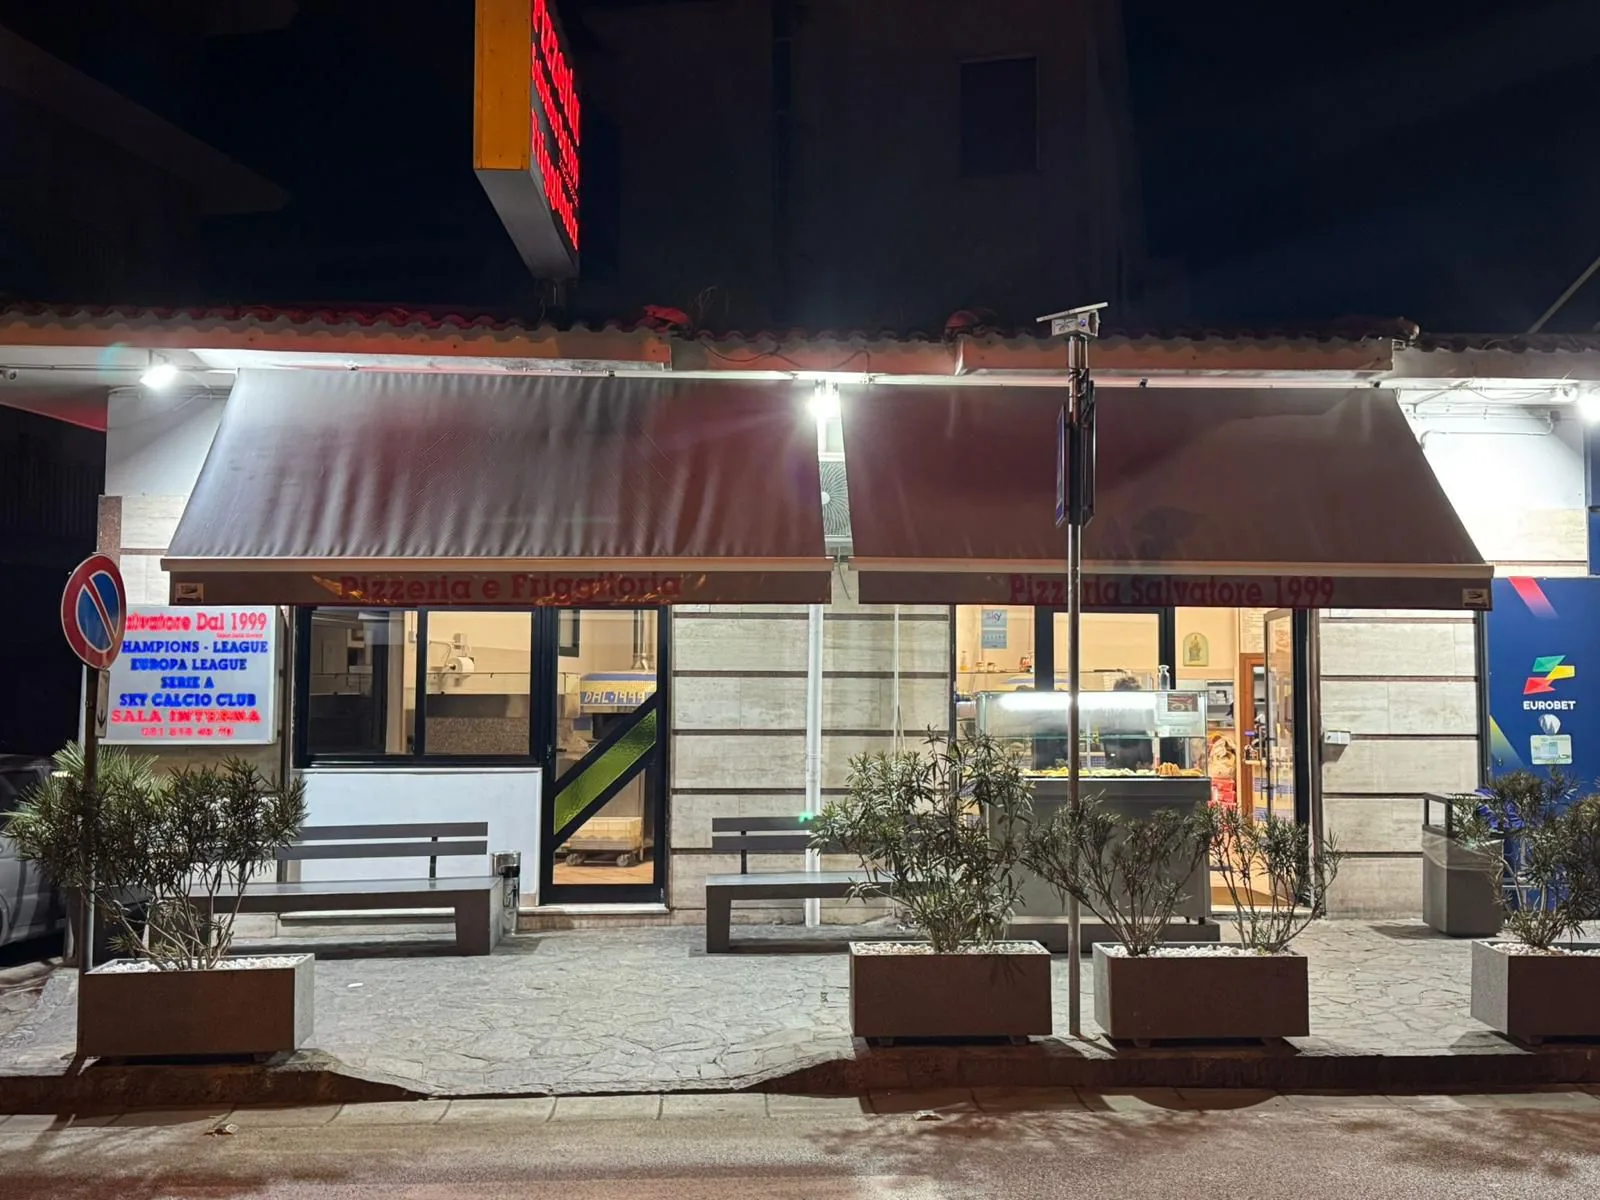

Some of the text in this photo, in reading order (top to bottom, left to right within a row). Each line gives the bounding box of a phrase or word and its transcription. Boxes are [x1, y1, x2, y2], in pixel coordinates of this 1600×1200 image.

[340, 575, 471, 600] Pizzeria
[483, 578, 501, 598] e
[1008, 574, 1335, 605] Pizzria Salvatore 1999
[125, 612, 267, 631] alvatore Dal 1999
[121, 640, 200, 653] HAMPIONS
[213, 640, 268, 653] LEAGUE
[131, 658, 247, 671] EUROPA LEAGUE
[160, 676, 215, 689] SERIE A
[119, 693, 257, 707] SKY CALCIO CLUB
[1523, 700, 1576, 711] EUROBET
[111, 710, 260, 723] SALA INTERNA
